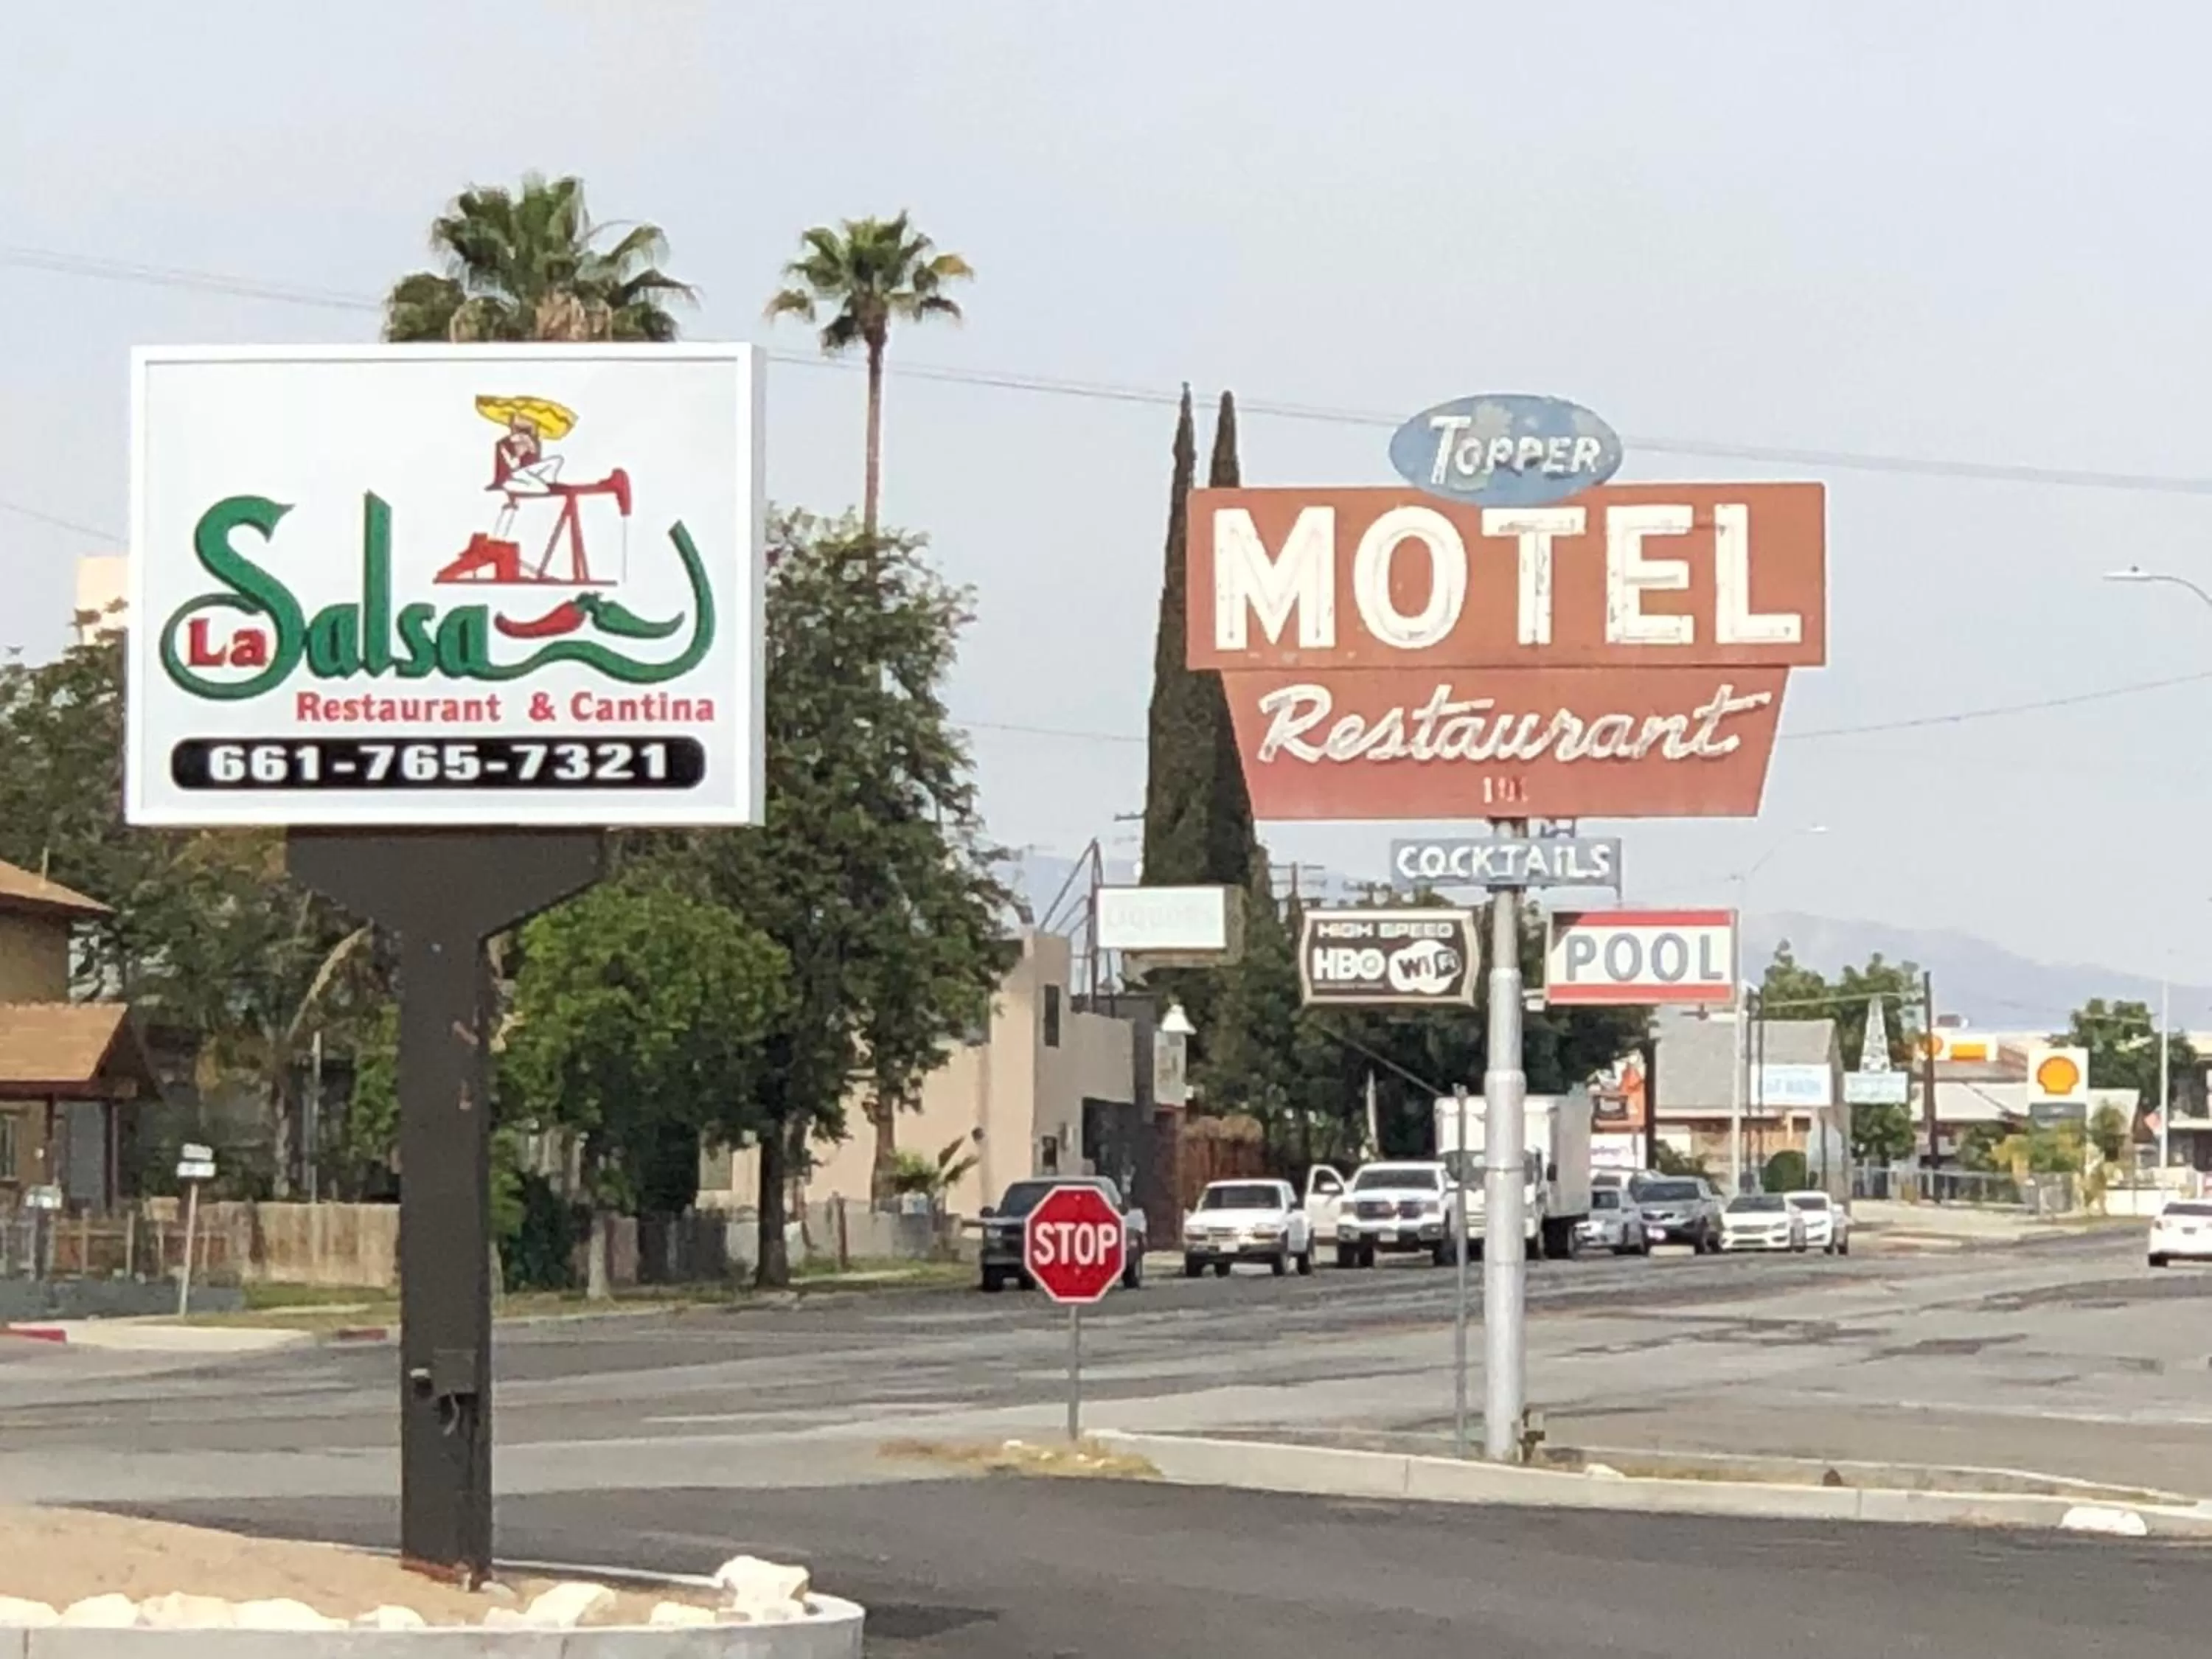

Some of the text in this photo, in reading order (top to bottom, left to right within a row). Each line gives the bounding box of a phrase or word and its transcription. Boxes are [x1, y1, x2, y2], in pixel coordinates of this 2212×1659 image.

[1429, 415, 1602, 485] TOPPER
[160, 488, 493, 701] La Salsa
[1213, 504, 1802, 650] MOTEL
[296, 691, 715, 722] Restaurant & Cantina
[1257, 684, 1771, 764] Restaurant
[209, 744, 667, 782] 661-765-7321
[1396, 843, 1612, 879] COCKTAILS
[1379, 922, 1453, 939] SPEED
[1313, 947, 1385, 980] HBO
[1565, 933, 1724, 981] POOL
[1033, 1222, 1117, 1265] STOP
